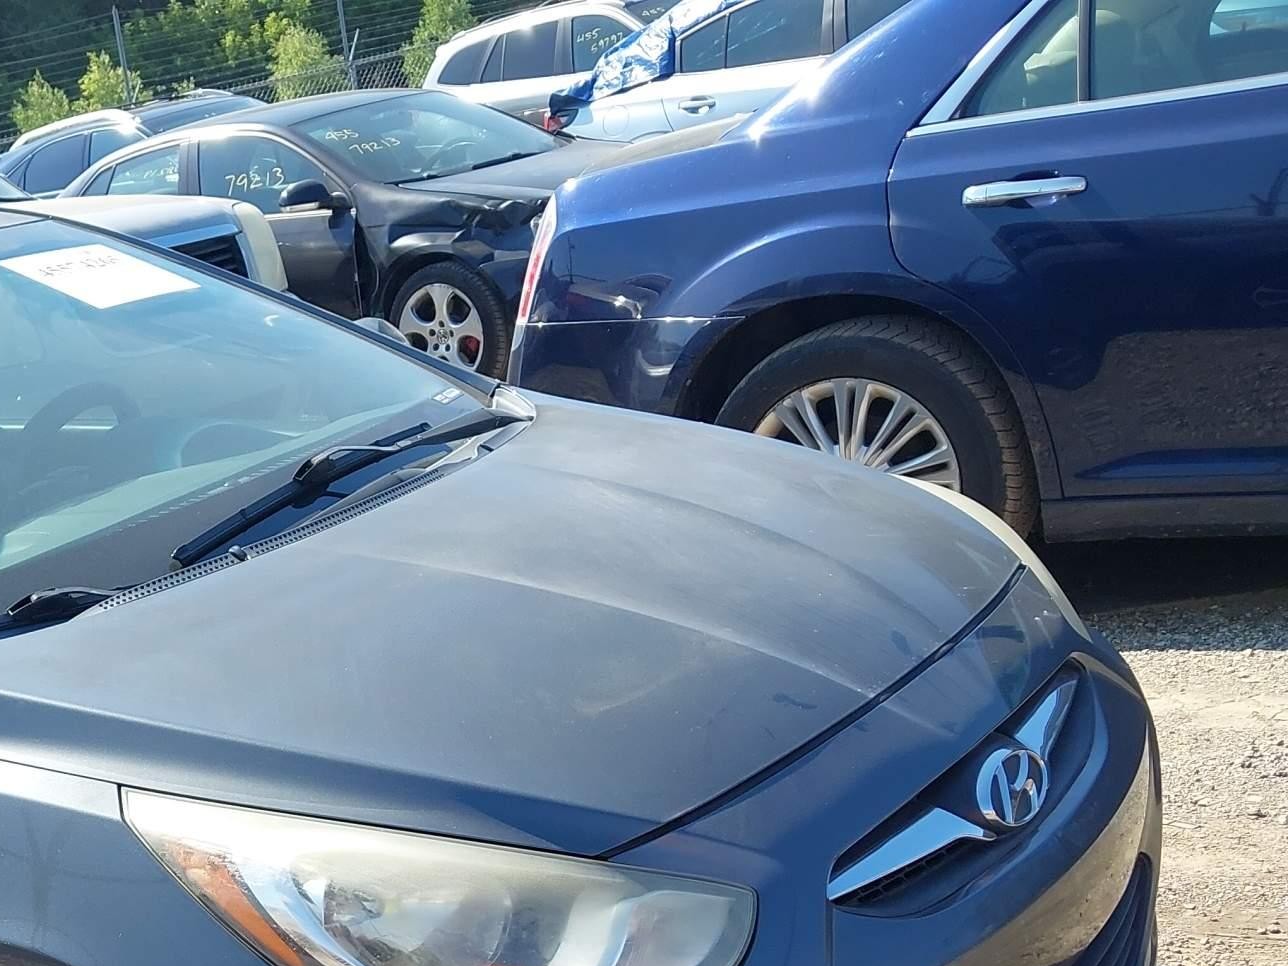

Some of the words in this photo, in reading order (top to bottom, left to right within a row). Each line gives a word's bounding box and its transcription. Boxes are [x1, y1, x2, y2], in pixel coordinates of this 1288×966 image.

[325, 129, 359, 141] 455
[348, 137, 401, 155] 79213
[224, 167, 285, 197] 79213
